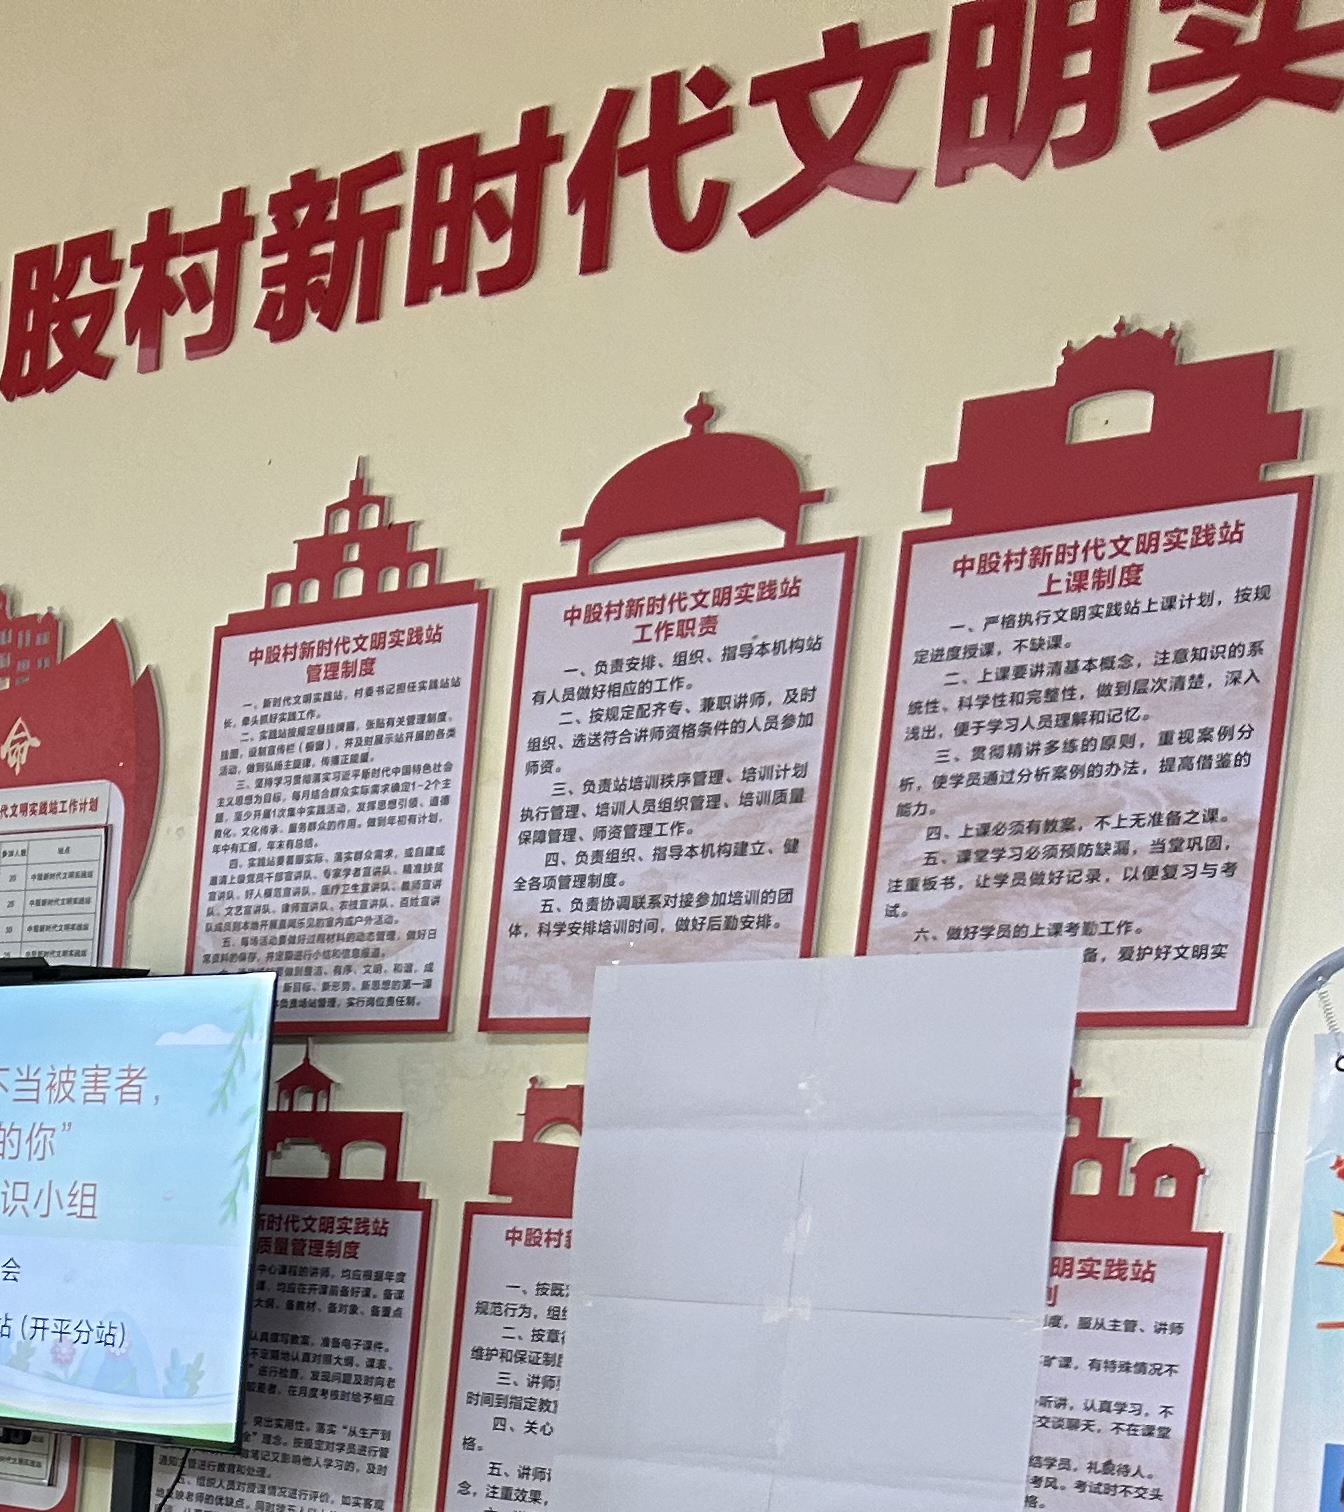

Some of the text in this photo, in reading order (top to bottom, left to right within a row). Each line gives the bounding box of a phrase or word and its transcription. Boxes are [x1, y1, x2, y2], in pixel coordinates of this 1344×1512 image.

[951, 519, 1245, 579] 中股村新时代文明实践站
[1037, 562, 1145, 597] 上课制度
[562, 575, 802, 627] 中股村新时代文明实践站
[948, 584, 1272, 635] 一、严格执行文明实践站上课计划，按规
[248, 623, 443, 666] 中股村新时代文明实践站
[632, 614, 719, 644] 工作职责
[563, 635, 823, 679] 一、负责安排、组织、指导本机构站
[912, 633, 1073, 665] 定进度授课，不缺课。
[943, 640, 1265, 687] 二、上课要讲清基本概念，注意知识的系
[305, 656, 376, 683] 管理制度
[531, 674, 694, 706] 有人员做好相应的工作。
[907, 667, 1262, 716] 统性、科学性和完整性，做到层次清楚，深入
[558, 686, 817, 727] 二、按规定配齐专、兼职讲师，及时
[526, 711, 814, 753] 组织、选送符合讲师资格条件的人员参加
[904, 705, 1151, 741] 浅出，便于学习人员理解和记忆。
[934, 723, 1254, 764] 三、贯彻精讲多练的原则，重视案例分
[524, 759, 562, 776] 师资。
[551, 762, 808, 798] 三、负责站培训秩序管理、培训计划
[898, 750, 1251, 792] 析，使学员通过分析案例的办法，提高借鉴的
[519, 787, 805, 823] 执行管理、培训人员组织管理、培训质量
[895, 800, 936, 817] 能力。
[517, 819, 694, 846] 保障管理、师资管理工作。
[925, 807, 1229, 841] 四、上课必须有教案，不上无准备之课。
[544, 837, 799, 868] 四、负责组织、指导本机构建立、健
[512, 872, 626, 892] 全各项管理制度。
[887, 860, 1238, 893] 注重板书，让学员做好记录，以便复习与考
[539, 887, 794, 915] 五、负责协调联系对接参加培训的团
[884, 902, 909, 918] 试。
[913, 919, 1143, 942] 六、做好学员的上课考勤工作。
[256, 1236, 360, 1259] 质量管理制度
[1049, 1255, 1157, 1283] 明实践站
[501, 1325, 565, 1344] 二、按章
[496, 1370, 561, 1390] 三、讲师
[1039, 1354, 1179, 1377] 旷课，有特殊情况不
[1034, 1394, 1174, 1418] 听讲，认真学习，不
[492, 1416, 554, 1436] 四、关心
[461, 1435, 484, 1452] 格。
